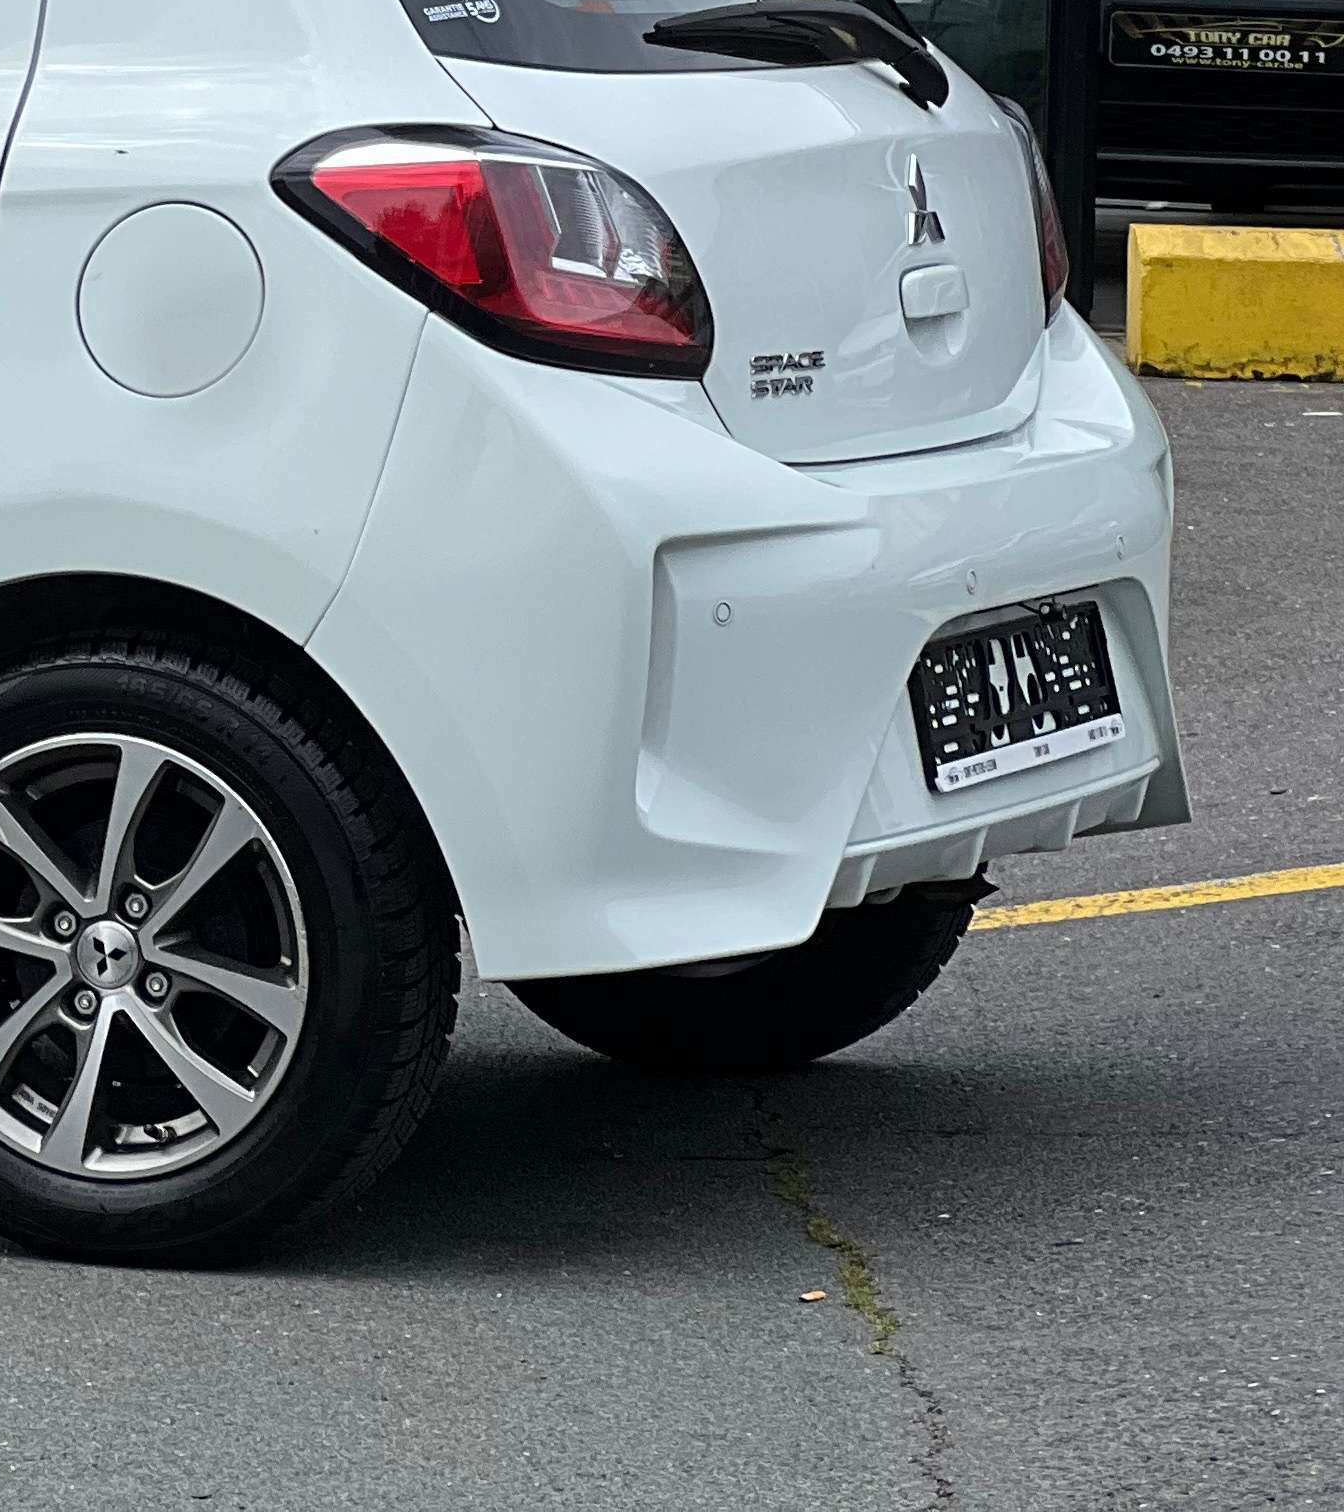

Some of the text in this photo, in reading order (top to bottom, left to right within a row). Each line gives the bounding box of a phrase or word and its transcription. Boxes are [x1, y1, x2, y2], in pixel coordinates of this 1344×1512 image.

[1187, 30, 1291, 47] TONY CAR
[1150, 44, 1326, 64] 0493 11 00 11
[1171, 56, 1304, 70] www.tony-car.be
[750, 351, 826, 375] SPACE
[751, 375, 814, 399] STAR
